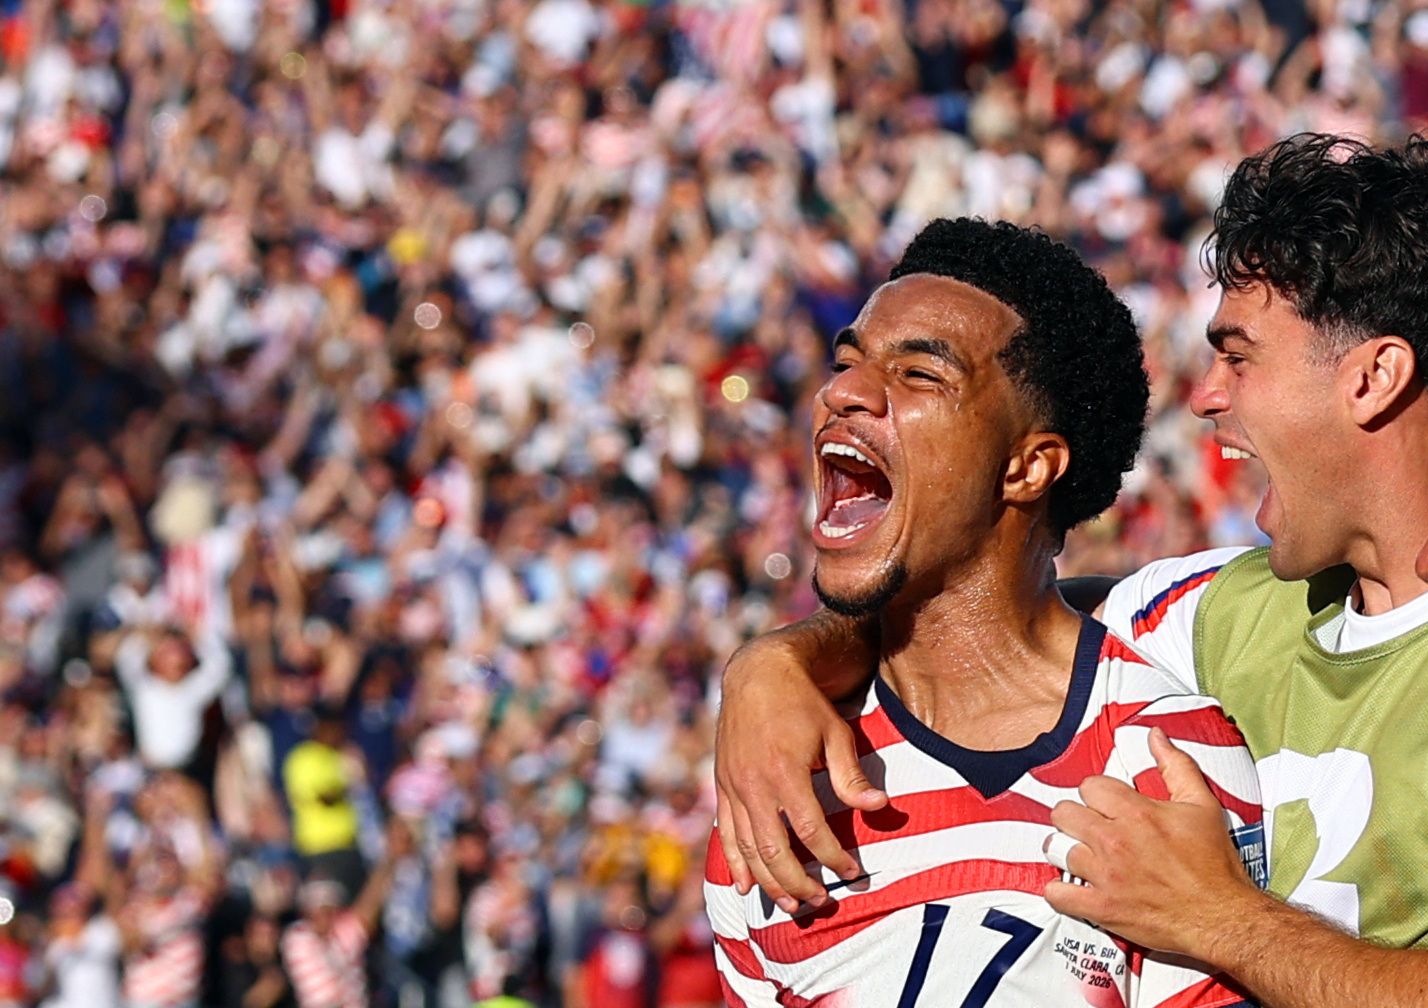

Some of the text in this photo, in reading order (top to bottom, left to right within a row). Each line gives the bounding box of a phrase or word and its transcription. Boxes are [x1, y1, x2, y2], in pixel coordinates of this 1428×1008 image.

[1063, 937, 1080, 951] USA
[1083, 943, 1097, 957] VS.
[1115, 964, 1125, 976] CA
